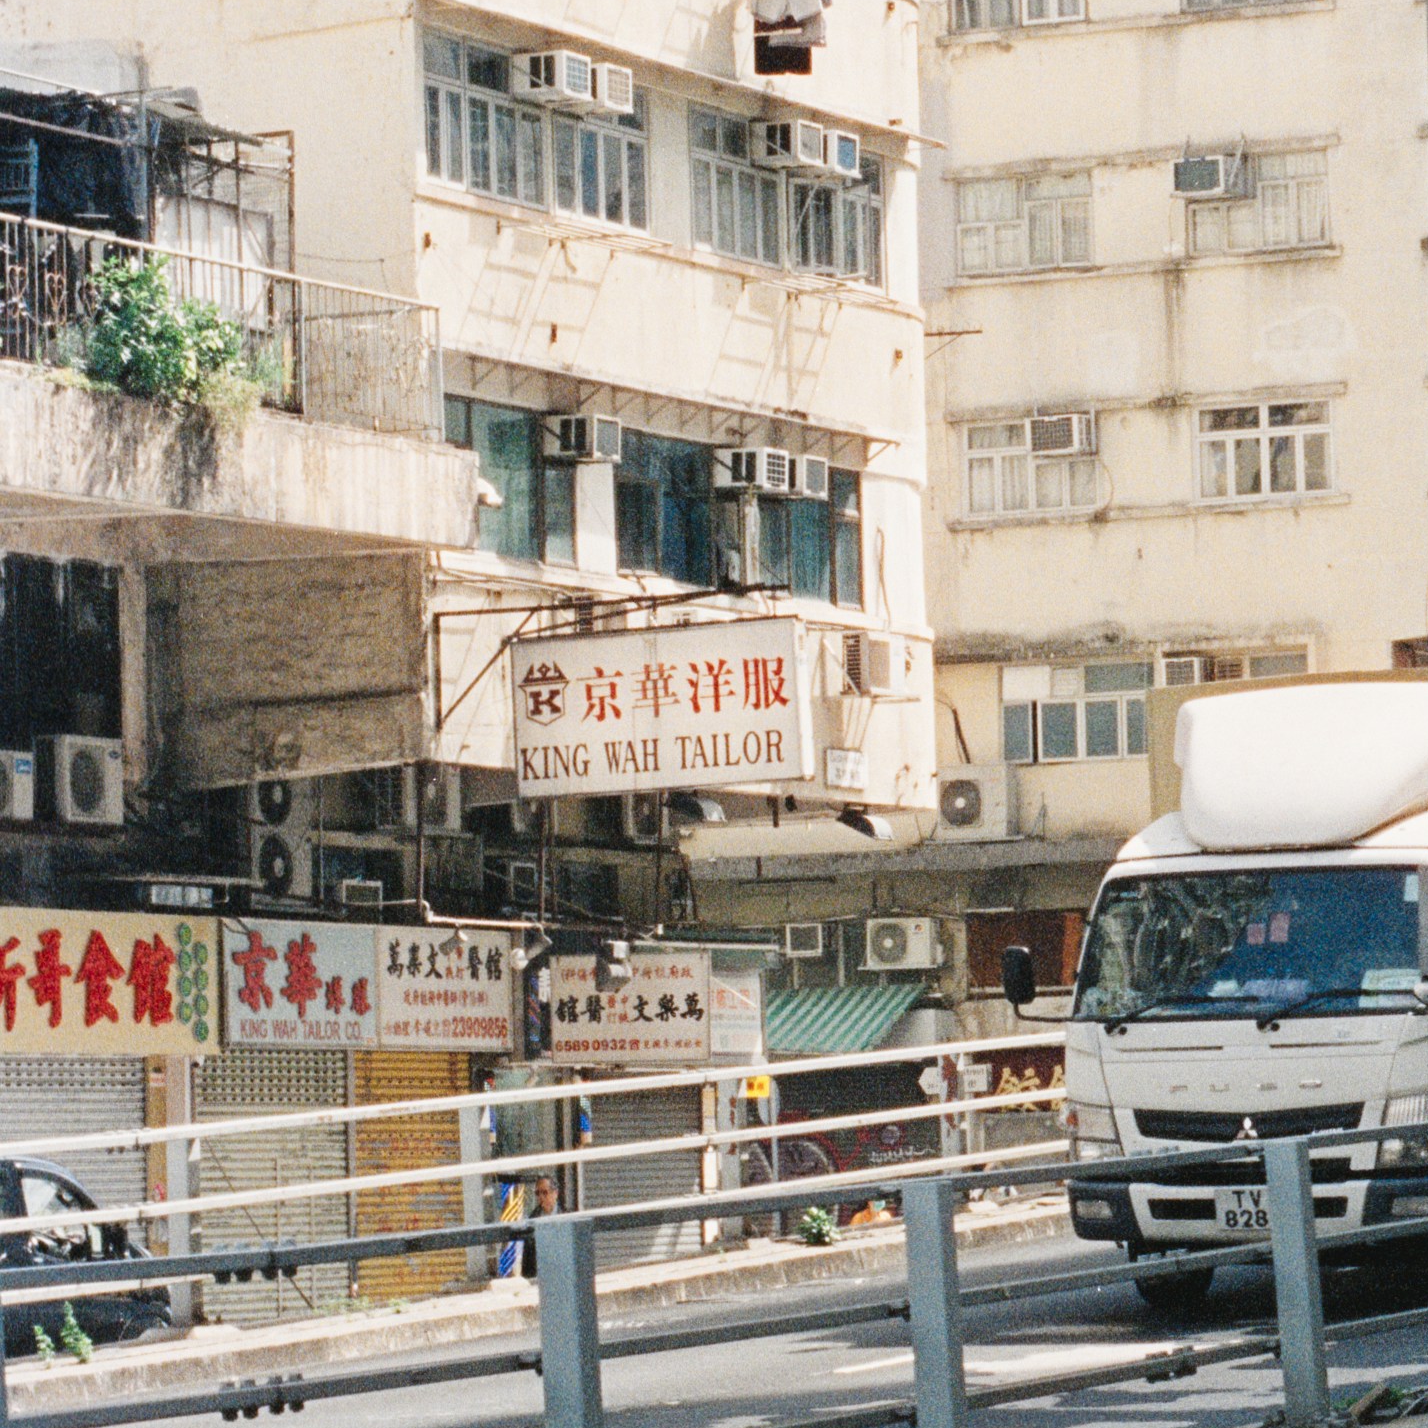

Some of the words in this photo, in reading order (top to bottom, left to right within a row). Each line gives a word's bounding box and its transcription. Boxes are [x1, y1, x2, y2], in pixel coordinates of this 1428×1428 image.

[576, 656, 790, 723] 京華洋服
[520, 743, 591, 781] KING
[604, 737, 661, 774] WAH
[675, 729, 785, 770] TAILOR
[240, 1019, 268, 1039] KING
[272, 1020, 298, 1039] WAH
[302, 1020, 341, 1041] TAILOR
[555, 1037, 628, 1053] 65890932
[1231, 1189, 1262, 1209] TV
[1224, 1209, 1269, 1228] 828
